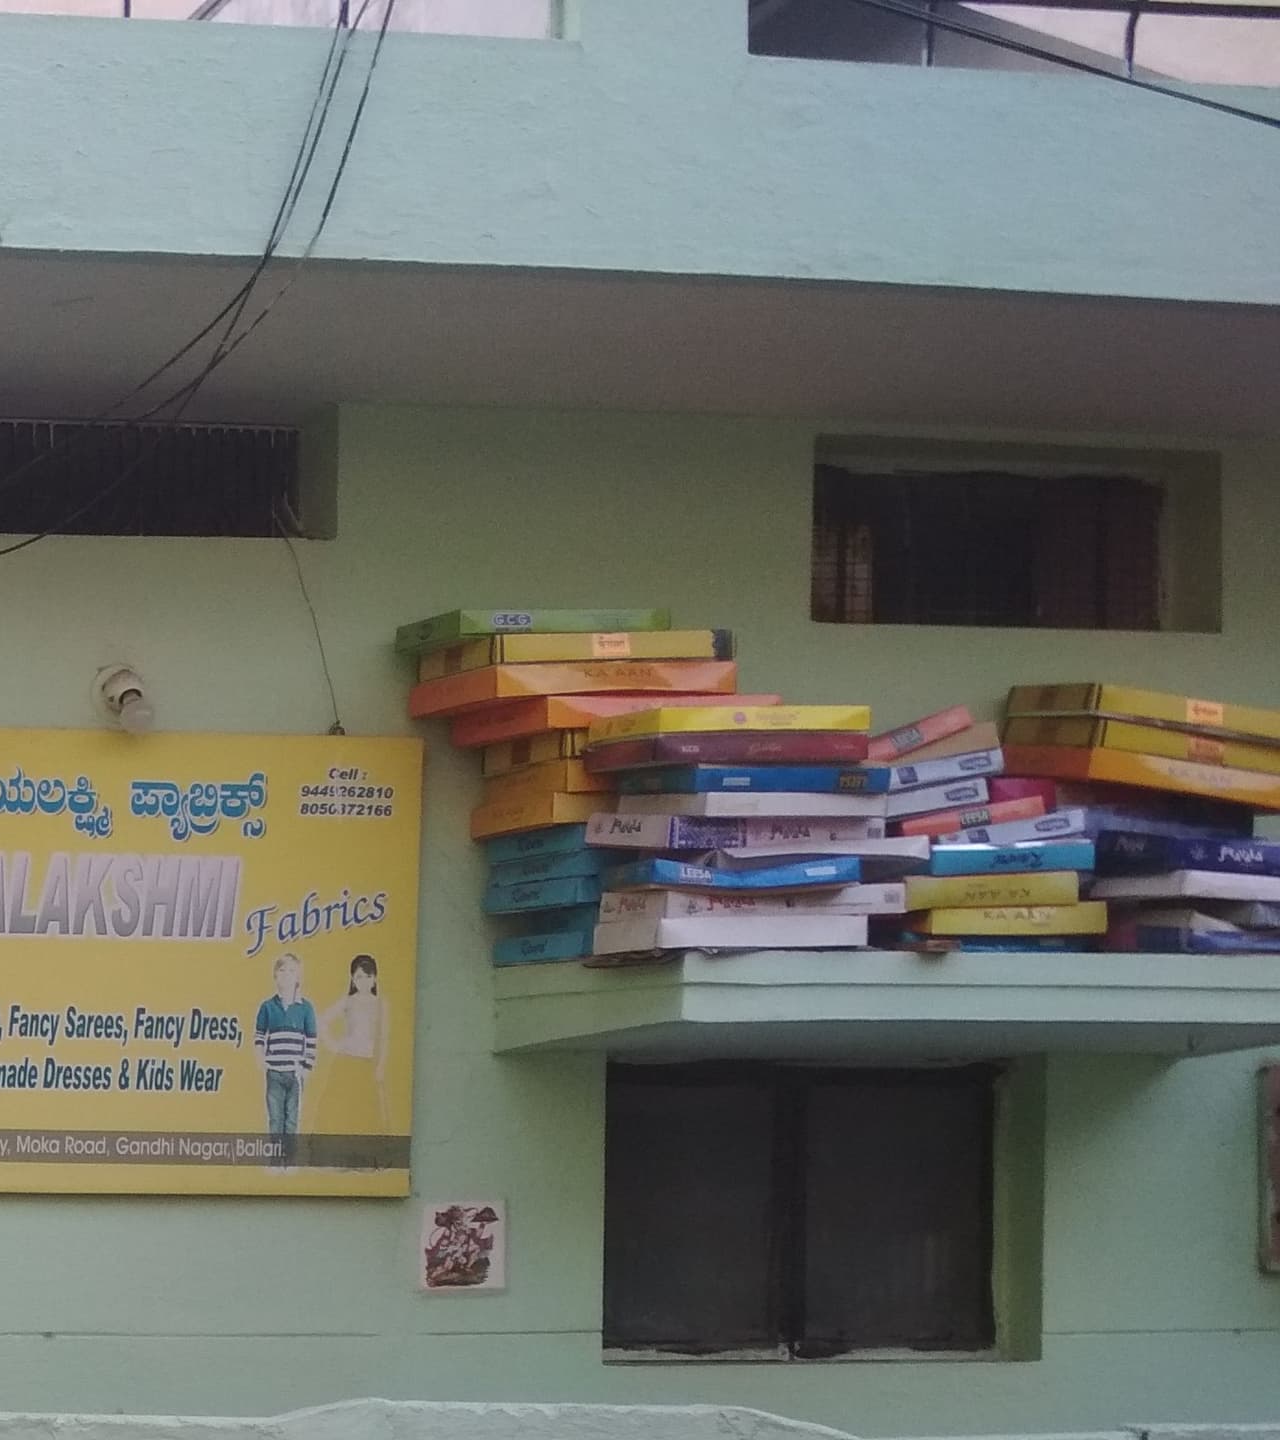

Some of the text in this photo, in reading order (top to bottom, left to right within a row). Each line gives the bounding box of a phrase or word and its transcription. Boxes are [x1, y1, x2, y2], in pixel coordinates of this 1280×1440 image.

[328, 767, 359, 781] Cell
[245, 888, 388, 956] Fabrics
[7, 1005, 60, 1047] Fancy
[64, 1006, 129, 1046] Sarees,
[133, 1007, 185, 1048] Fancy
[188, 1008, 243, 1047] Dress,
[42, 1057, 113, 1090] Dresses
[117, 1058, 131, 1090] &
[135, 1059, 175, 1091] Kids
[178, 1061, 224, 1092] Wear
[16, 1135, 60, 1154] Moka
[64, 1136, 110, 1156] Road,
[115, 1136, 175, 1157] Gandhi
[179, 1138, 231, 1160] Nagar,
